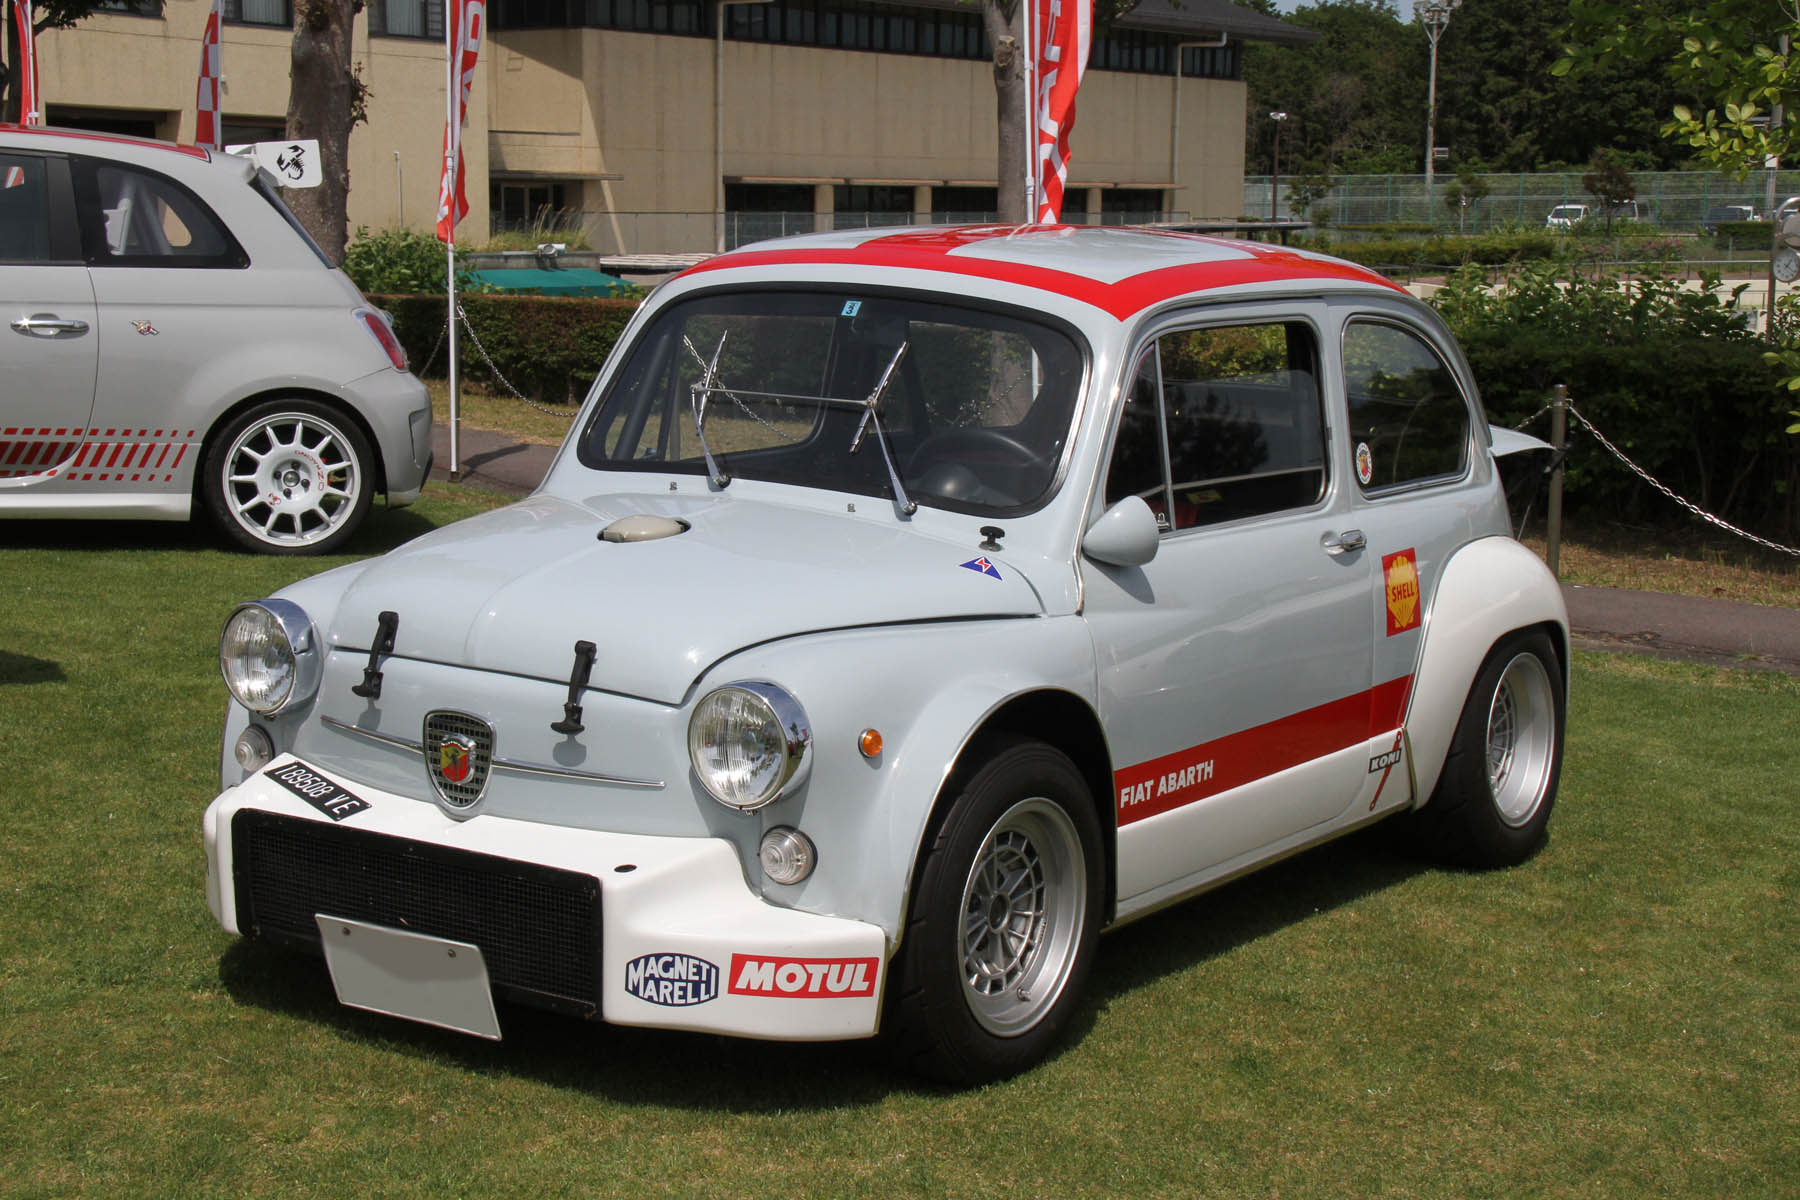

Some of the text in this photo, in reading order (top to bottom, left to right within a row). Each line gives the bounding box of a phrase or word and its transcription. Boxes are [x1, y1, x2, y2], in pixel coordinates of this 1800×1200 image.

[1391, 580, 1415, 603] SHELL
[1370, 748, 1401, 773] KONI
[274, 765, 360, 815] 189508 VE
[1120, 759, 1214, 809] FIAT ABARTH
[628, 955, 717, 985] MAGNETI
[735, 960, 870, 993] MOTUL
[628, 975, 717, 1004] MARELLI
